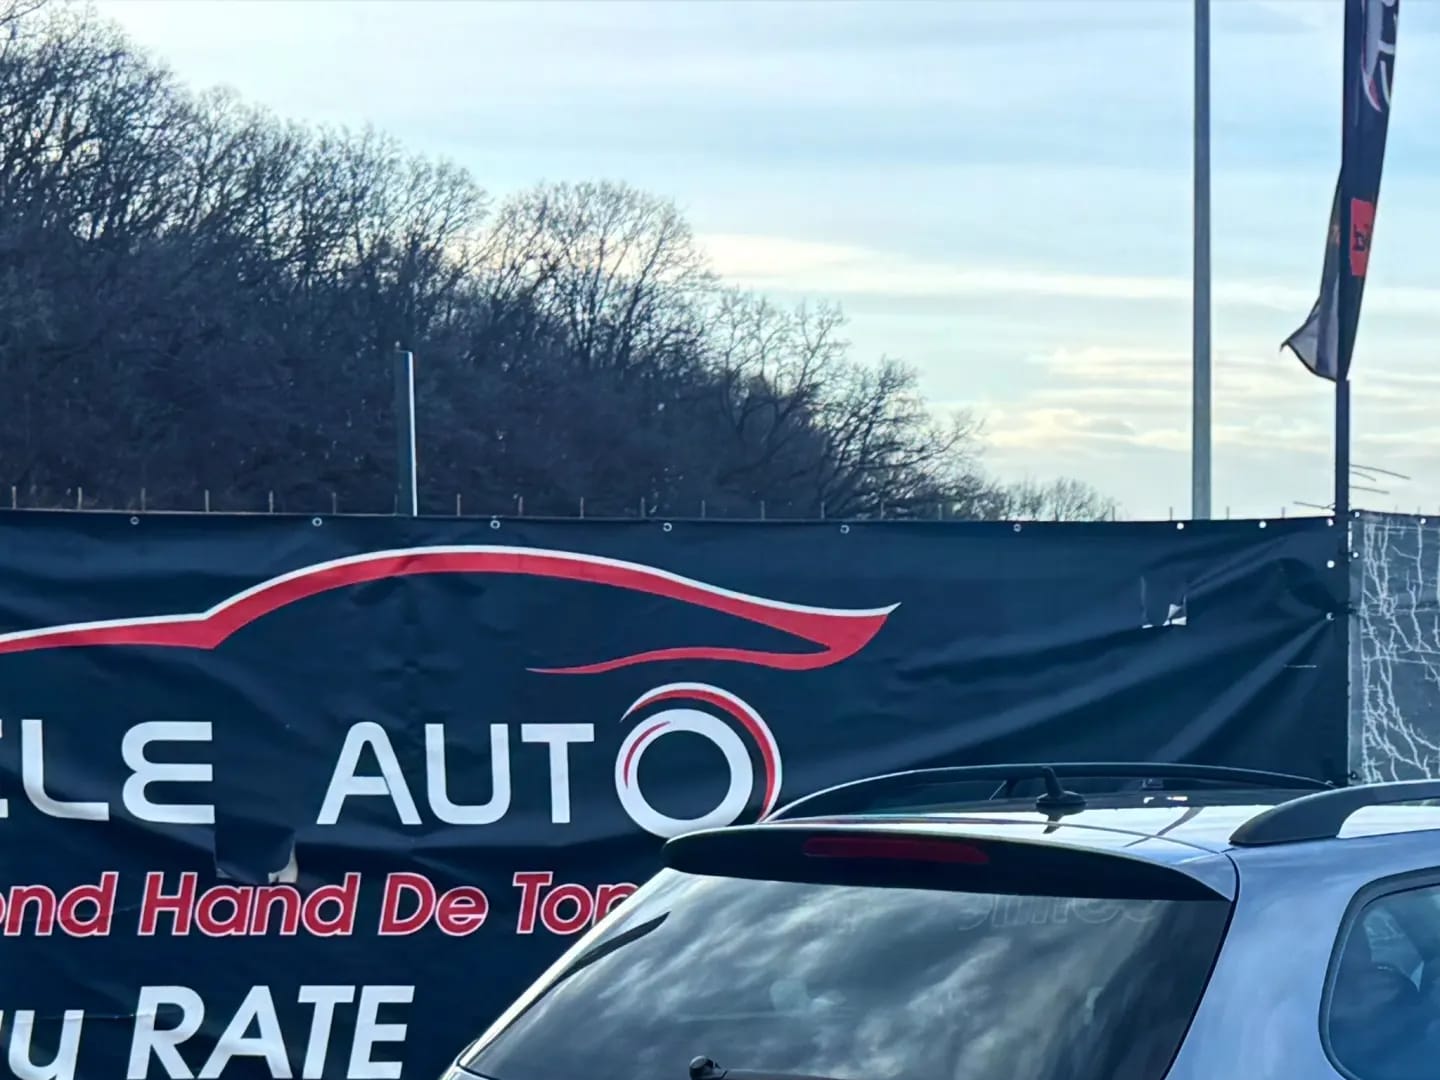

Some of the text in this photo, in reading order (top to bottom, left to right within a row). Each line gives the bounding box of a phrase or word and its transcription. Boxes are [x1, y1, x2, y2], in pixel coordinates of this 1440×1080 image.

[0, 706, 755, 838] LE AUTO
[0, 871, 118, 937] nd
[137, 871, 360, 937] Hand
[378, 872, 488, 937] De
[126, 985, 416, 1080] RATE
